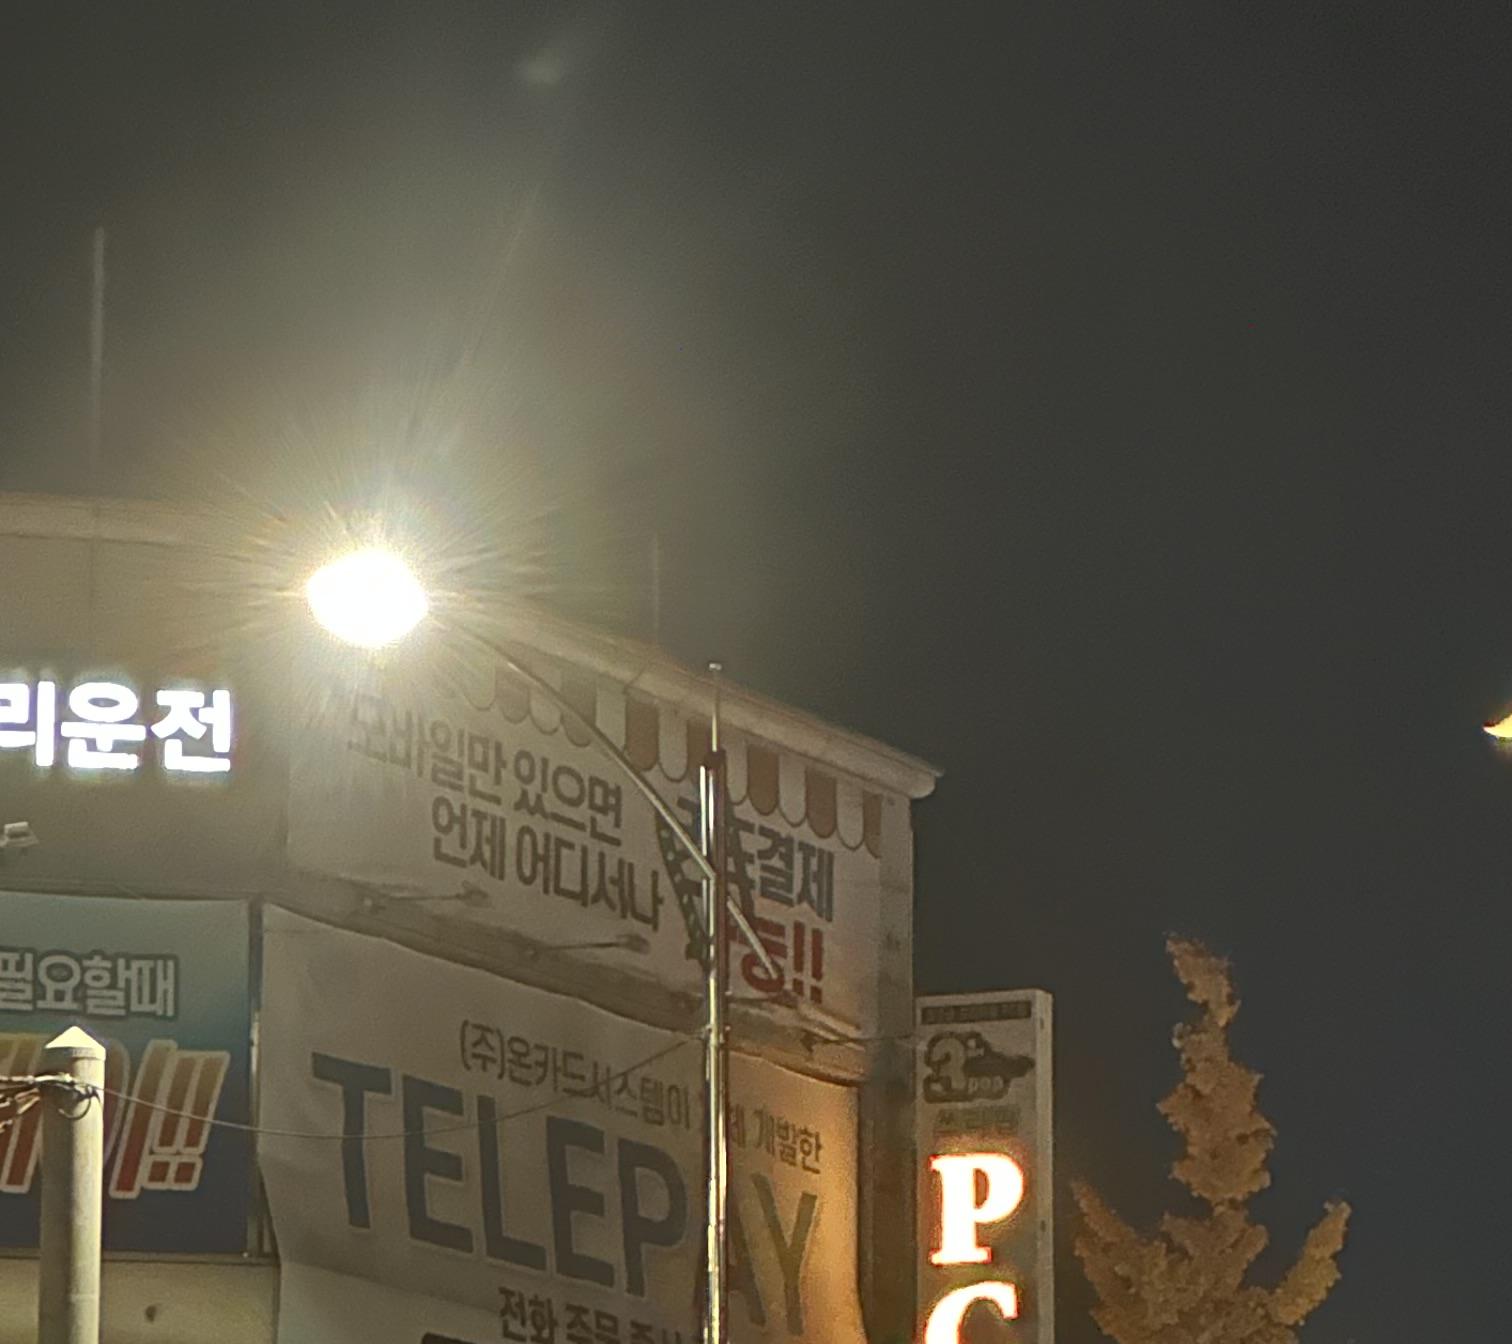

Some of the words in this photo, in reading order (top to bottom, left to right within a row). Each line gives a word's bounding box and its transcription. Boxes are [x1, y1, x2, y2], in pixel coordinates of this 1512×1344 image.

[513, 749, 622, 846] 있으면
[432, 794, 506, 882] 언제
[517, 826, 664, 933] 어디서나
[752, 1103, 823, 1175] 개발한
